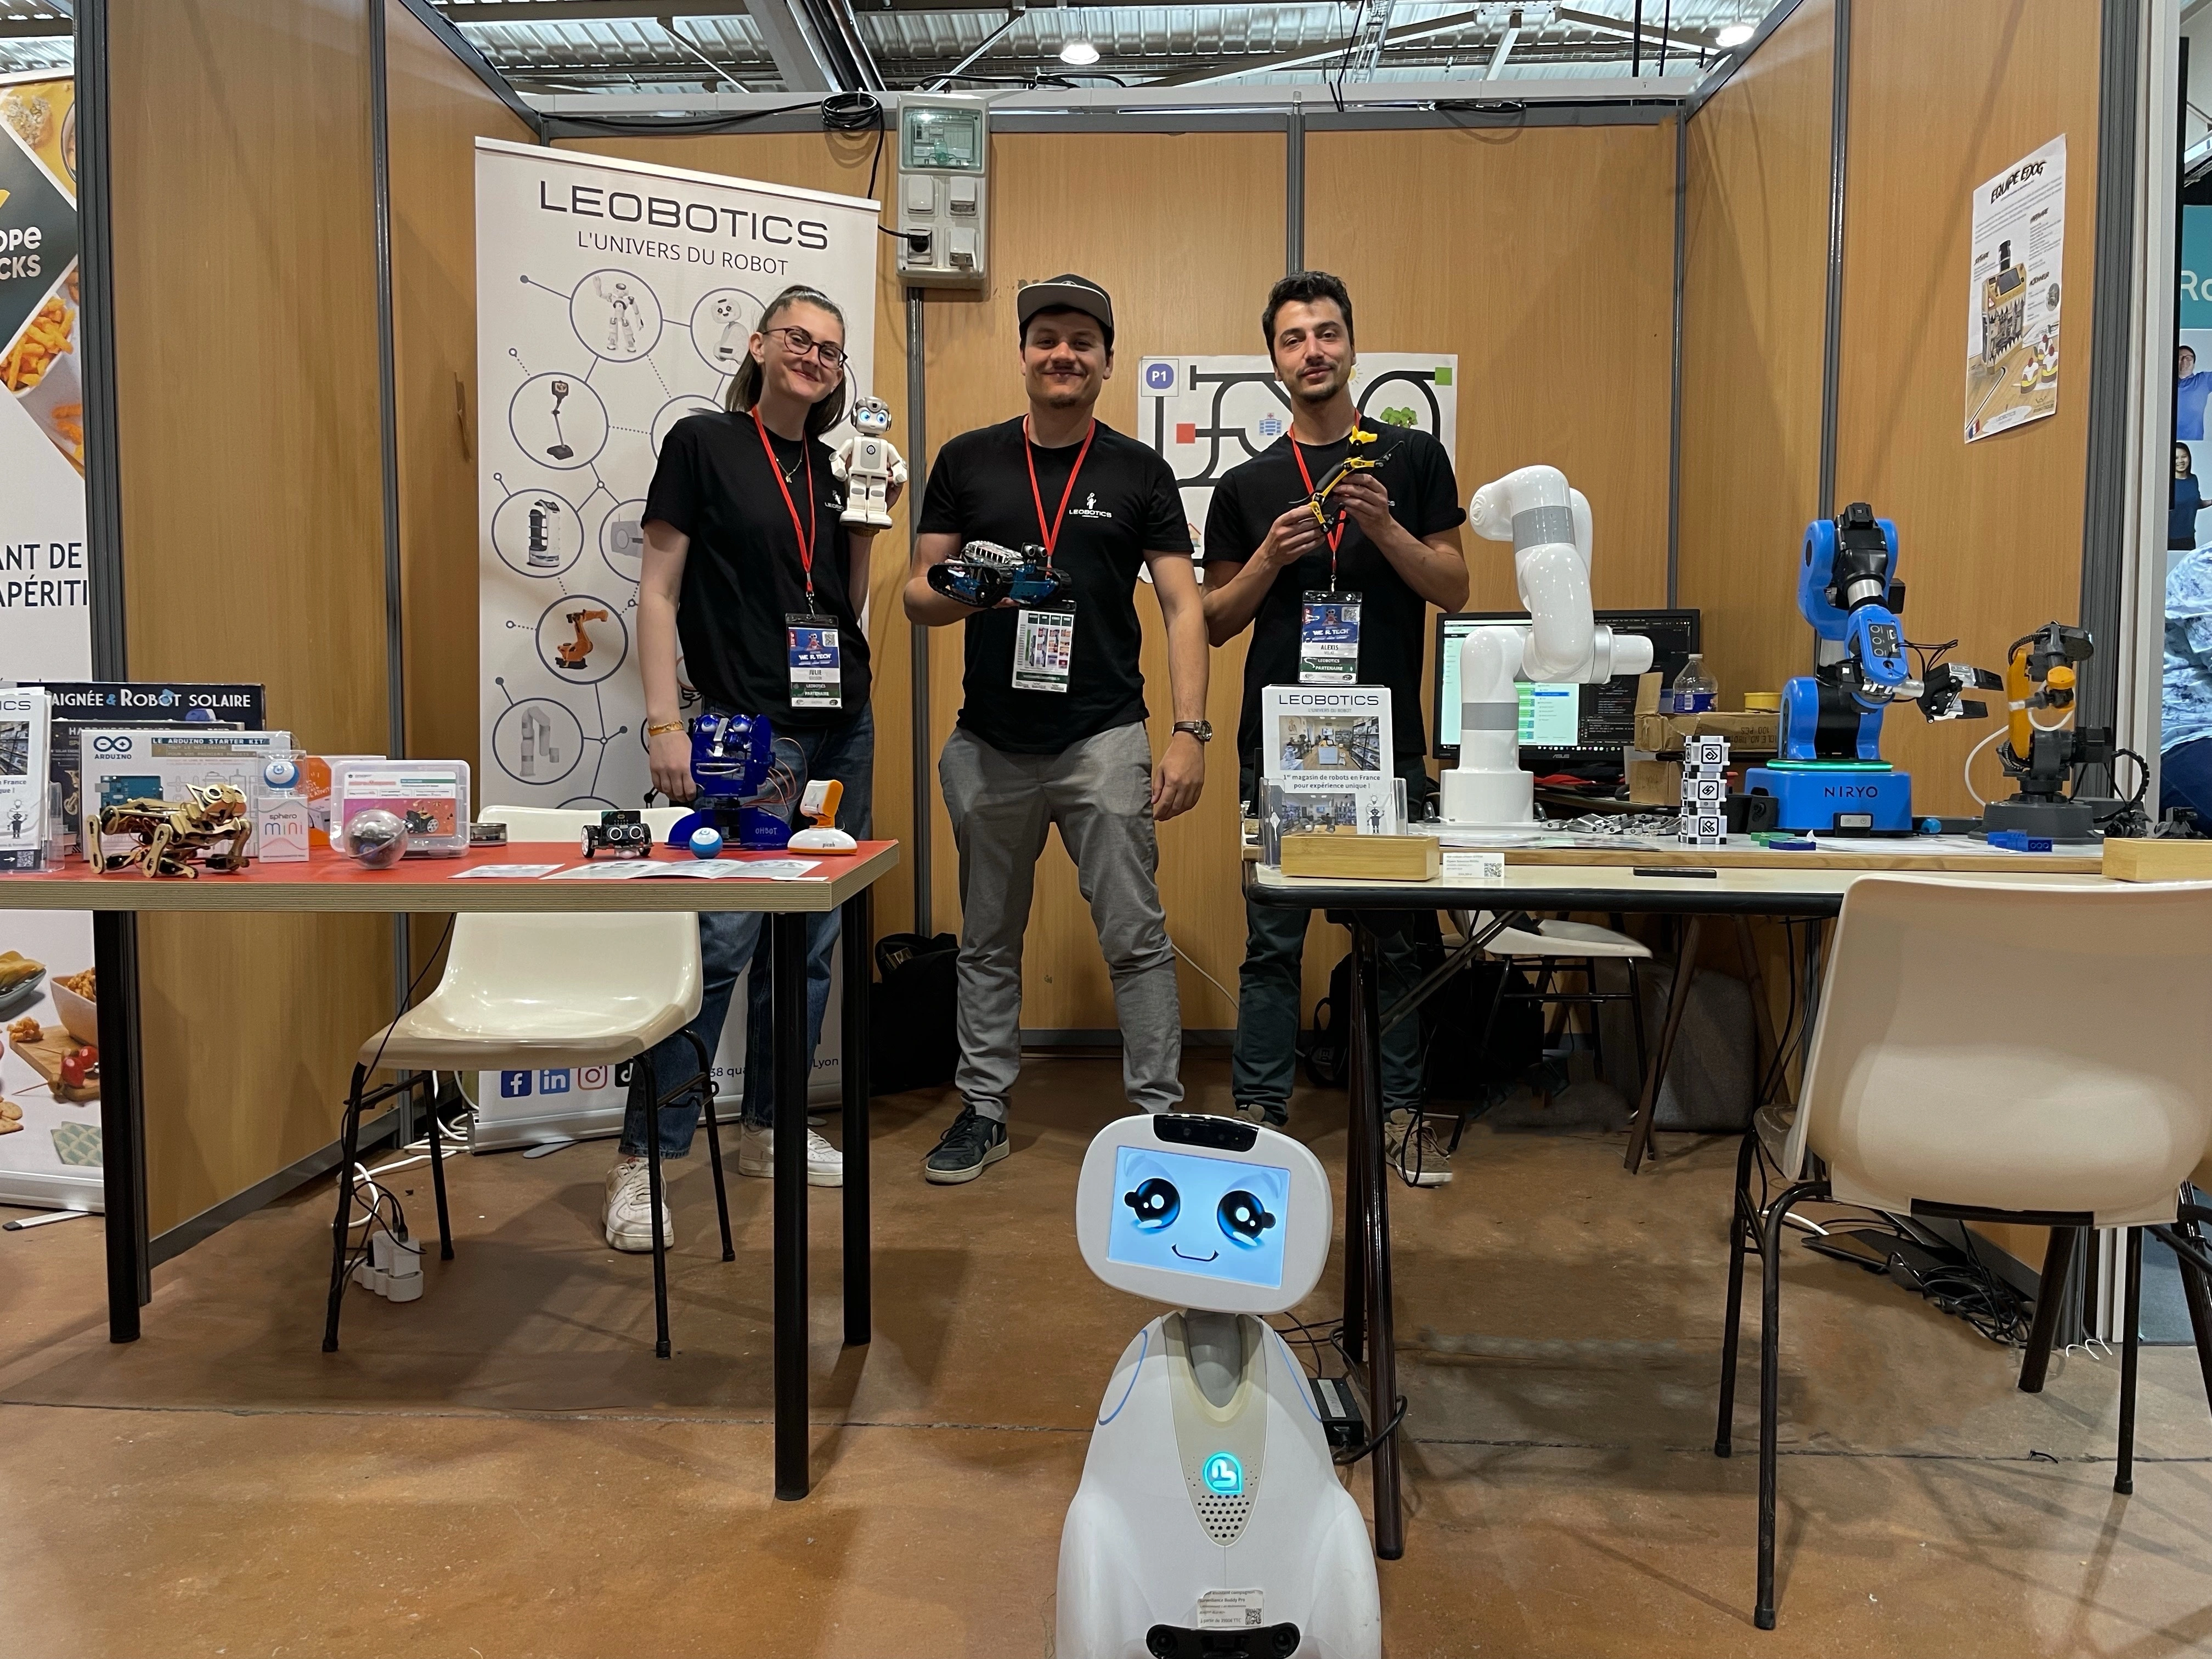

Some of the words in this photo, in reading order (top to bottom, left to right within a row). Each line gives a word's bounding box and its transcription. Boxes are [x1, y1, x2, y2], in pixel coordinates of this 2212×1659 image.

[540, 180, 828, 250] LEOBOTICS
[578, 230, 681, 261] L'UNIVERS
[687, 247, 715, 266] DU
[722, 252, 788, 275] ROBOT
[0, 254, 41, 280] CKS
[1152, 370, 1166, 382] P1
[1069, 509, 1112, 518] LEOBOTICS
[50, 542, 82, 569] DE
[106, 693, 116, 706] &
[189, 694, 251, 708] SOLAIRE
[1279, 694, 1379, 706] LEOBOTICS
[1824, 786, 1878, 798] NIRYO
[269, 812, 297, 821] sphero
[264, 822, 303, 835] mini
[812, 1058, 839, 1069] Lyon
